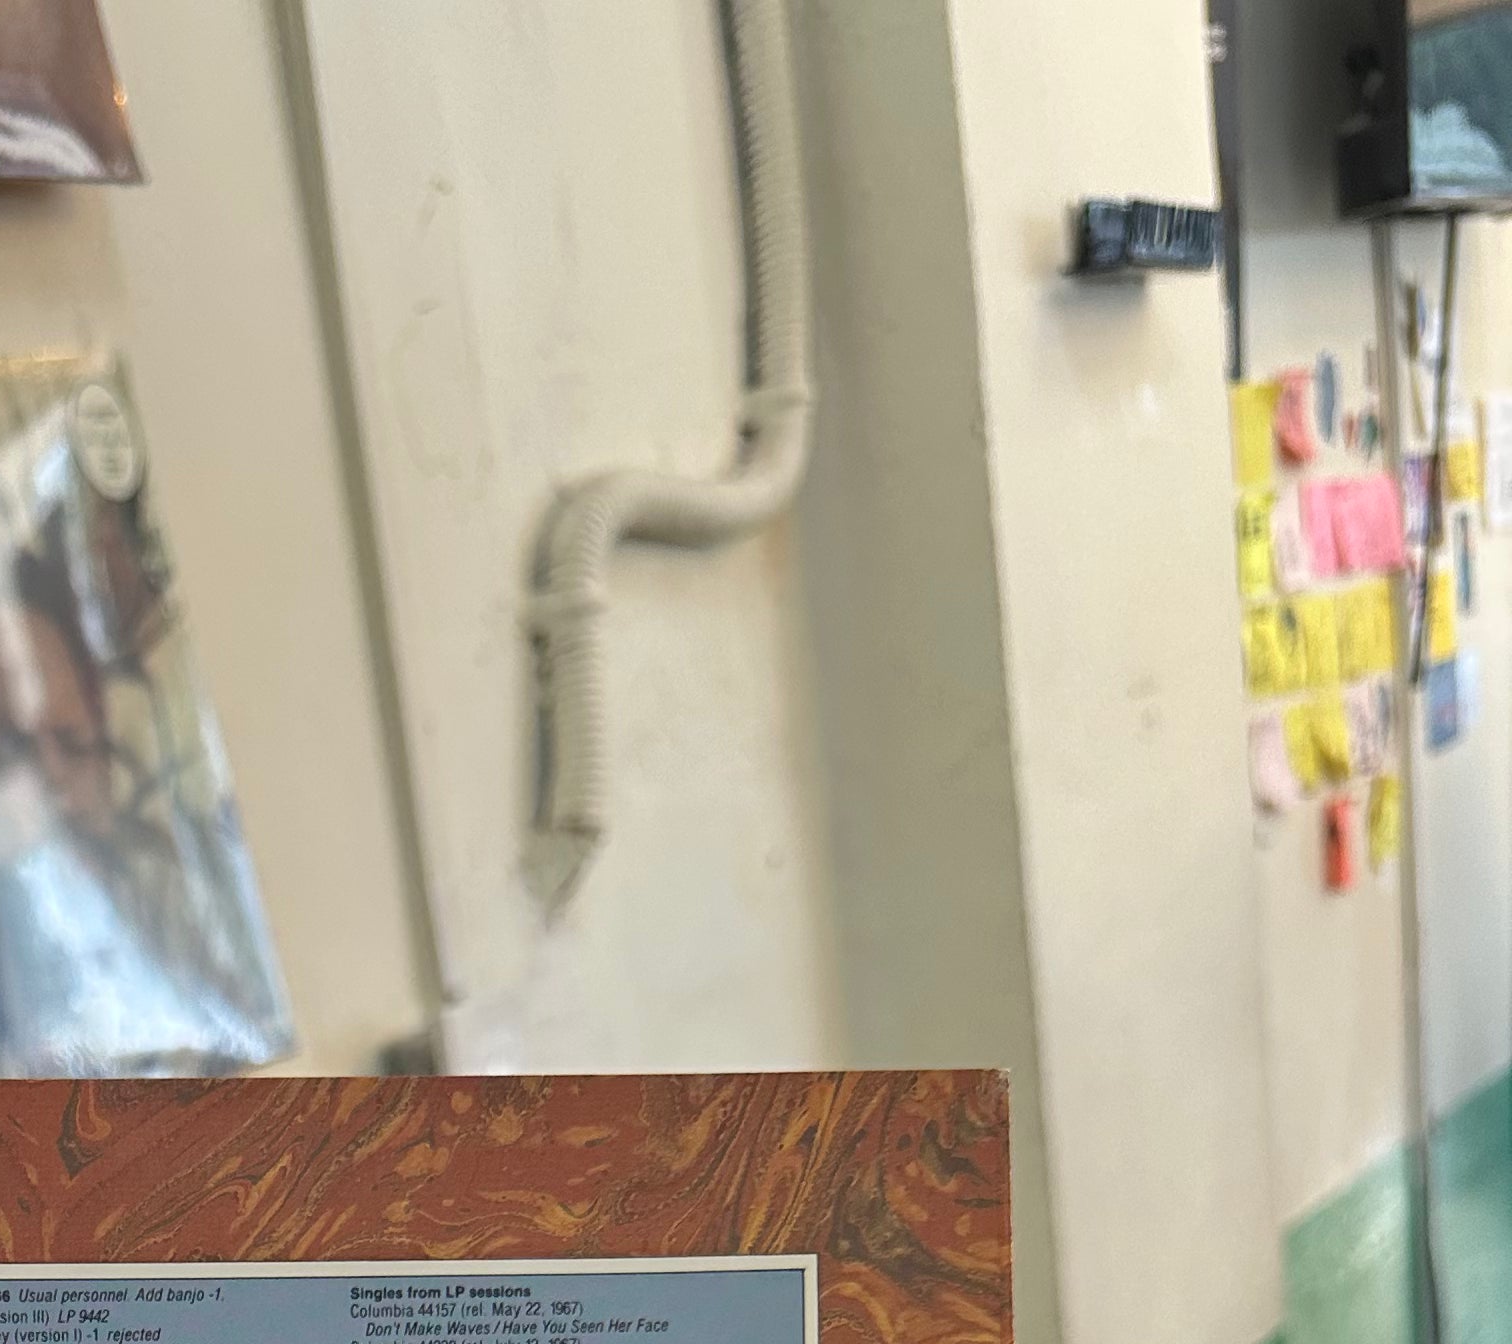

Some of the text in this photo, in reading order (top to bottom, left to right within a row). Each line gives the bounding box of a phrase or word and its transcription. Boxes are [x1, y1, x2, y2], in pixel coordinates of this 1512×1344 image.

[350, 1285, 531, 1302] Singles from LP sessions
